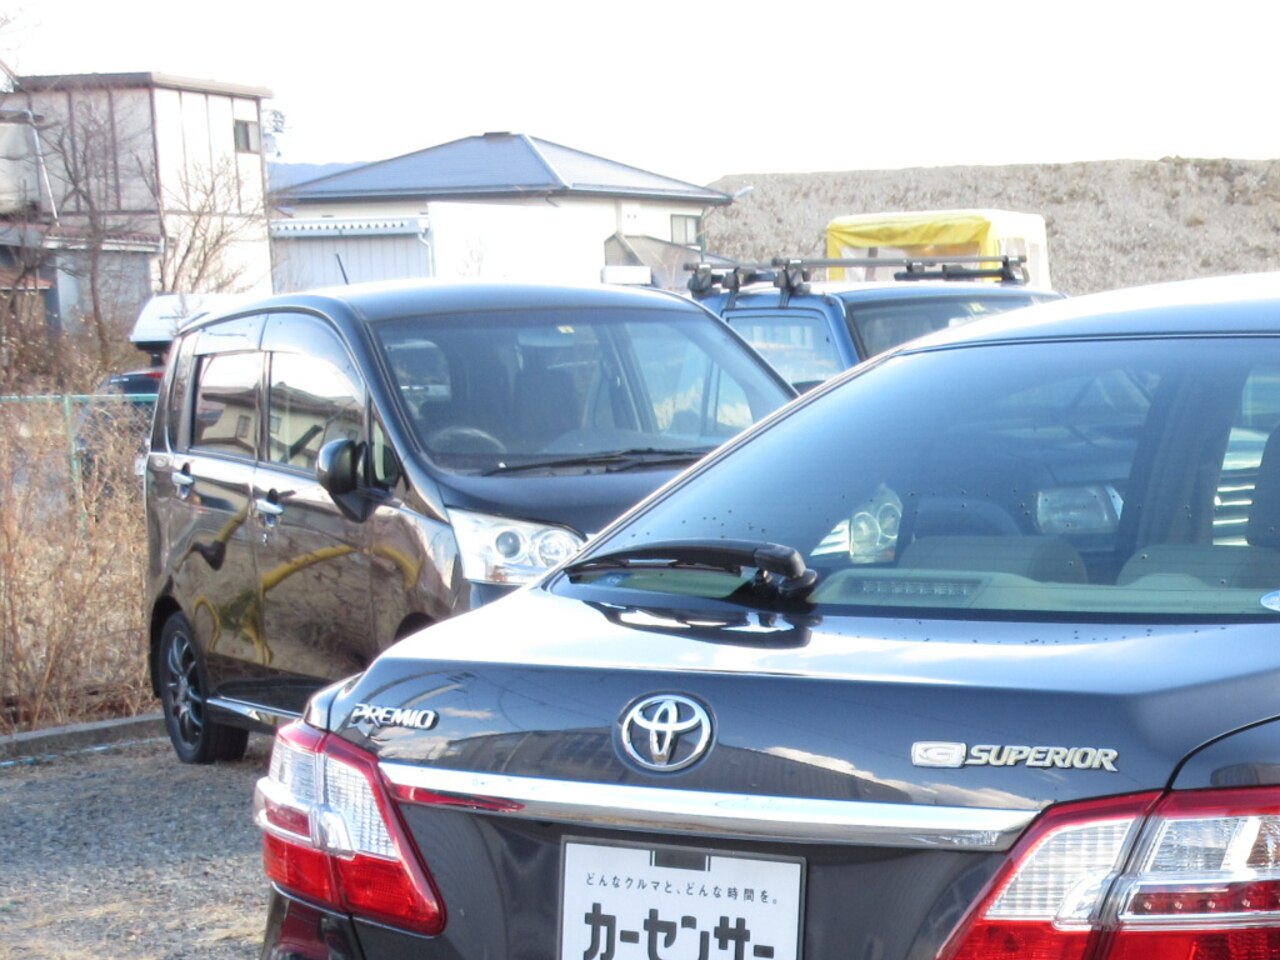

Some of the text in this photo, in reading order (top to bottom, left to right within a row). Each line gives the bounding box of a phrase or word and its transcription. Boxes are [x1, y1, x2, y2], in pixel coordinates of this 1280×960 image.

[350, 703, 436, 730] PREMIO
[965, 744, 1118, 772] SUPERIOR
[585, 872, 777, 904] どんなクルマと、どんな時間を。
